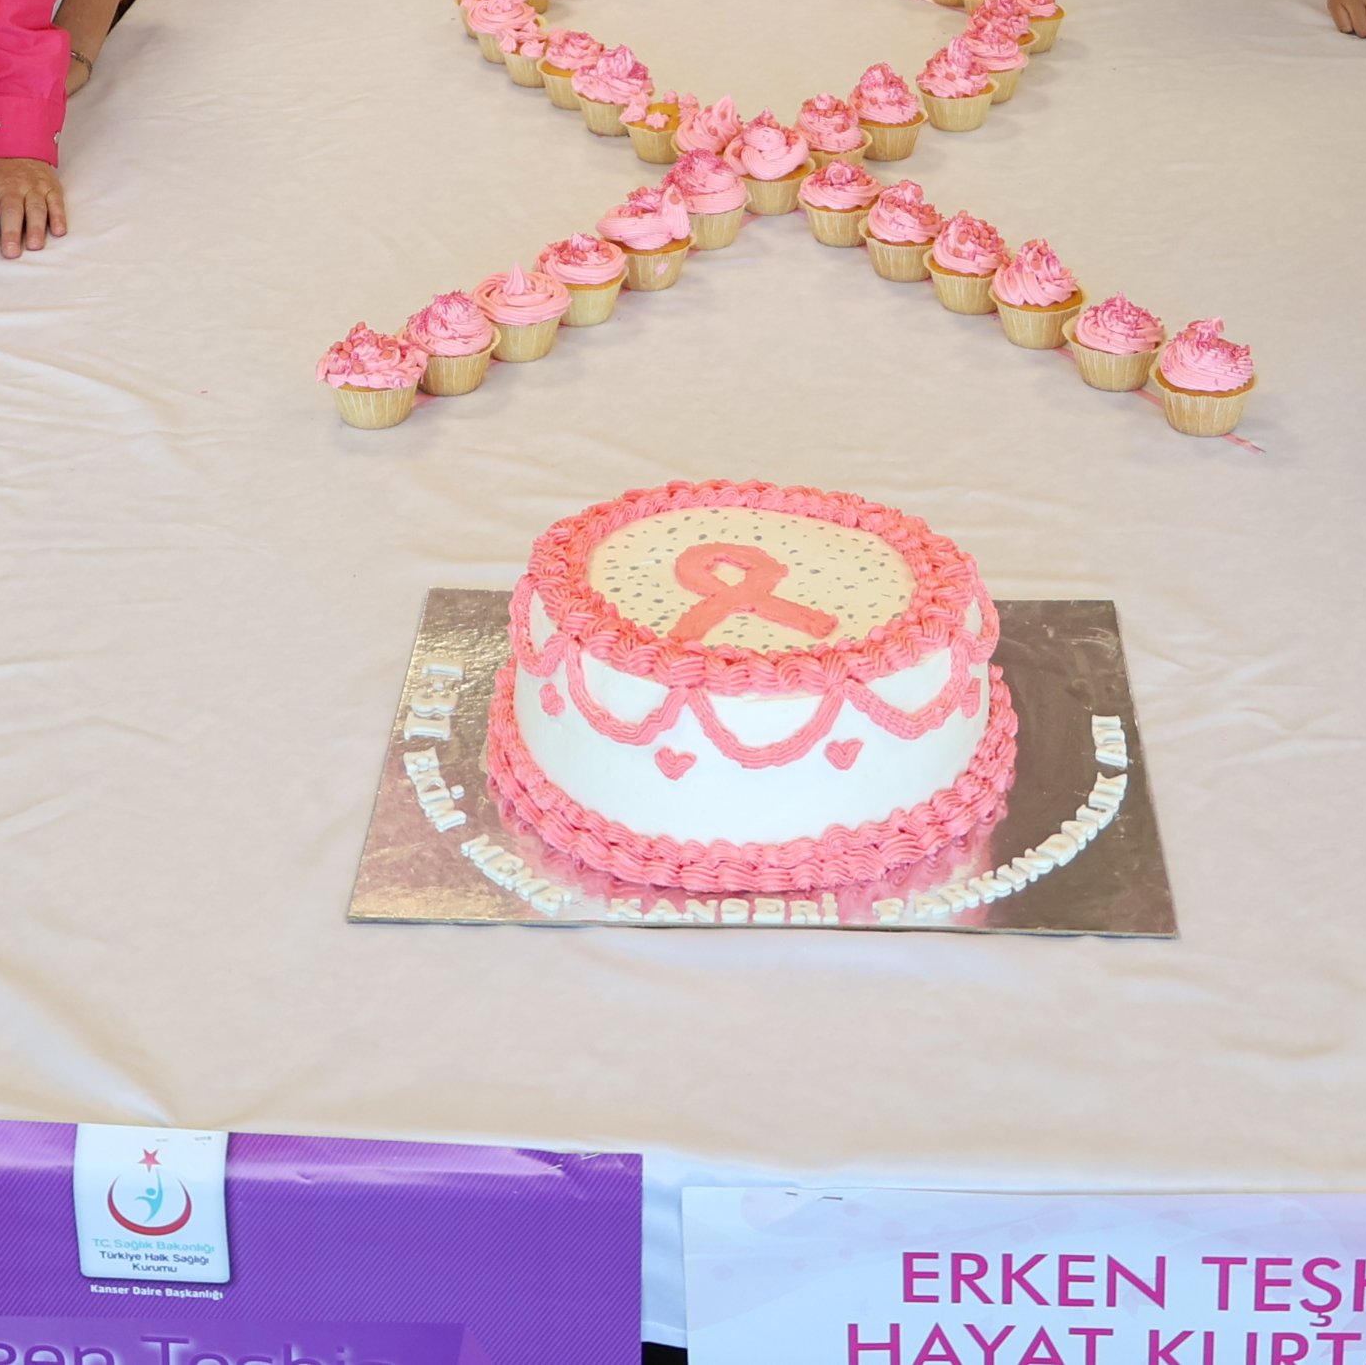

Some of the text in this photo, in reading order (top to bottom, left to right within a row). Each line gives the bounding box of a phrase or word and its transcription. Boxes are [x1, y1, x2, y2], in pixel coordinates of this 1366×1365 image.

[403, 746, 467, 833] EKİM
[460, 833, 572, 918] MEME
[607, 892, 839, 924] KANSERİ
[872, 771, 1128, 924] FARKINDALIK
[1091, 714, 1128, 771] AYI
[99, 1250, 209, 1266] Türkiye Halk Sağlığı
[132, 1262, 178, 1273] Kurumu
[90, 1284, 223, 1300] Kanser Daire Başkanlığı
[902, 1251, 1167, 1311] ERKEN
[847, 1321, 1115, 1365] HAYAT
